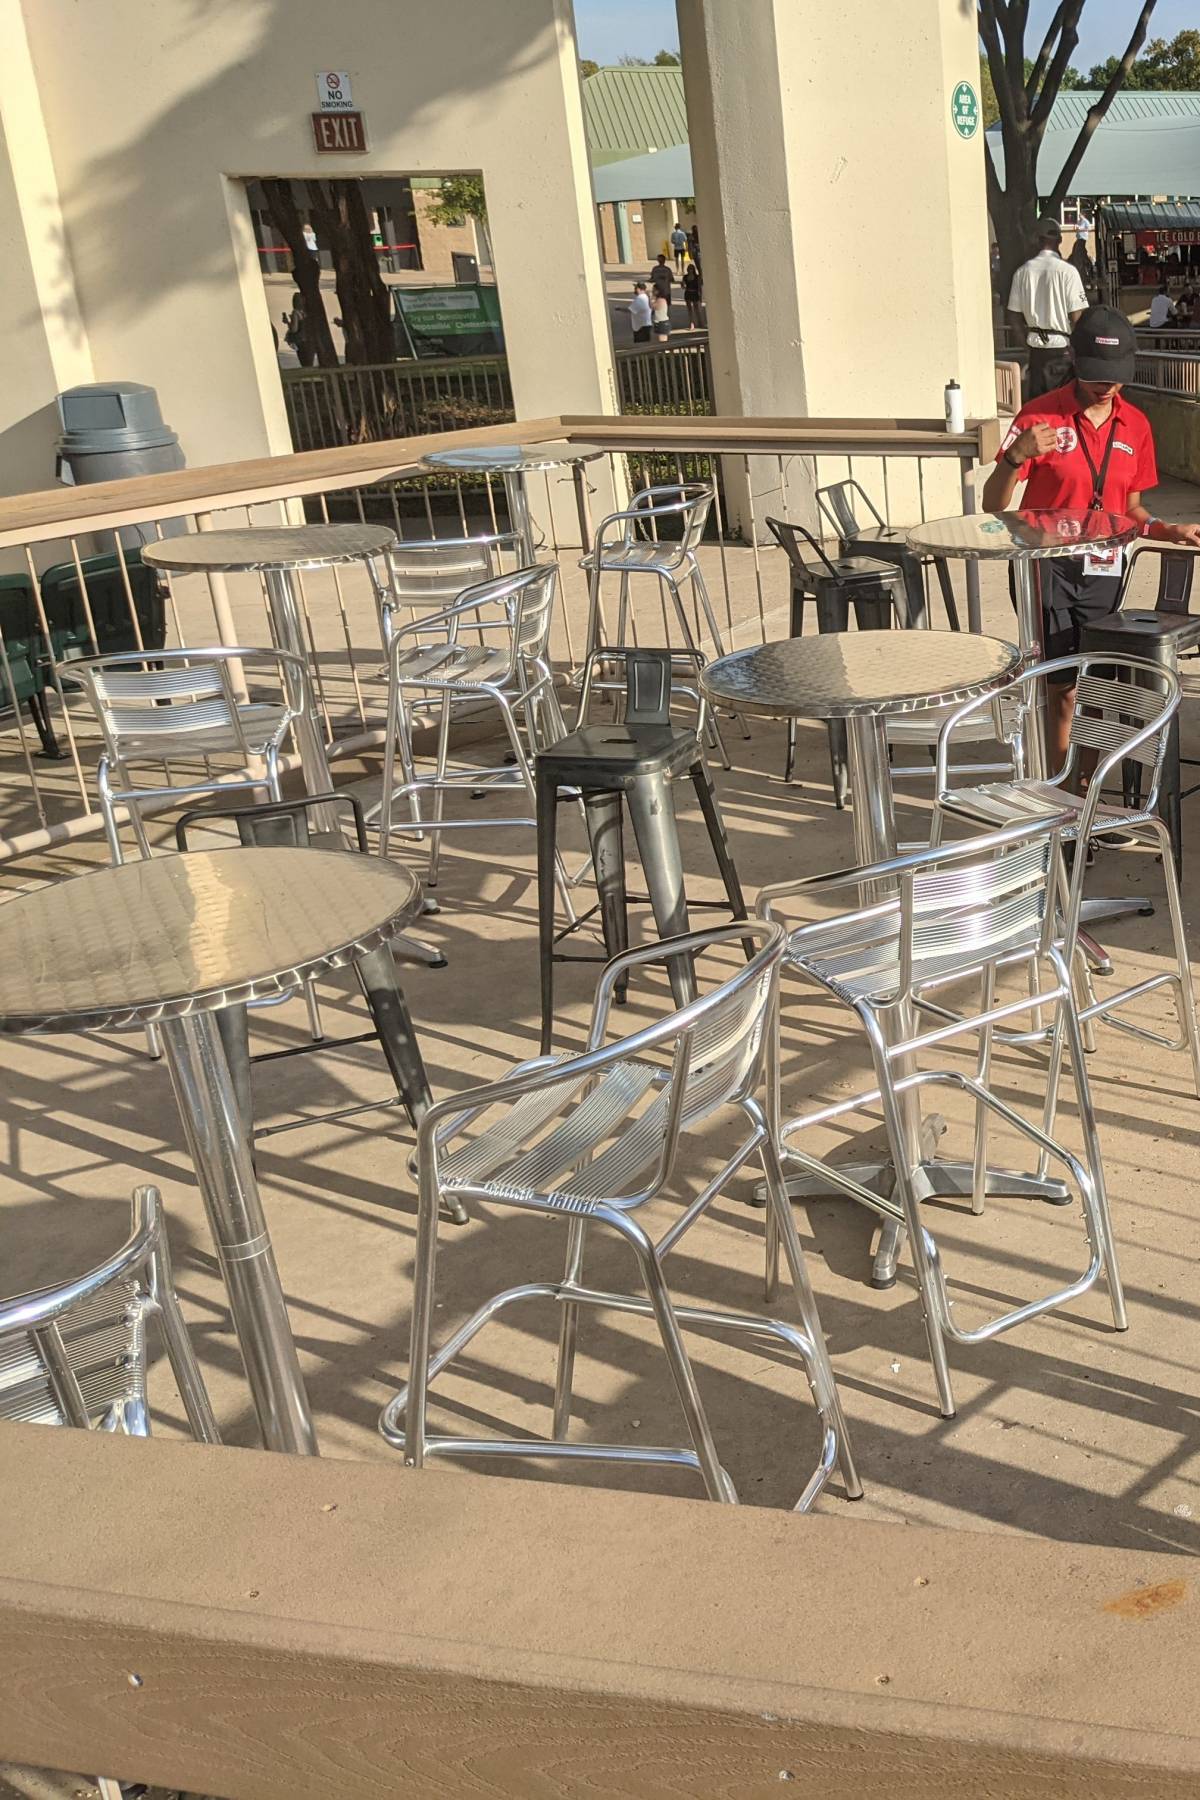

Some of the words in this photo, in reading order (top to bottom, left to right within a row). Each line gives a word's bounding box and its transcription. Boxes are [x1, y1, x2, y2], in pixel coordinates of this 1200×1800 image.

[328, 90, 343, 100] NO
[959, 94, 971, 104] AREA
[962, 105, 969, 114] OF
[956, 115, 975, 126] REFUGE
[321, 117, 358, 147] EXIT
[1156, 231, 1170, 242] ICE
[1172, 231, 1194, 242] COLD
